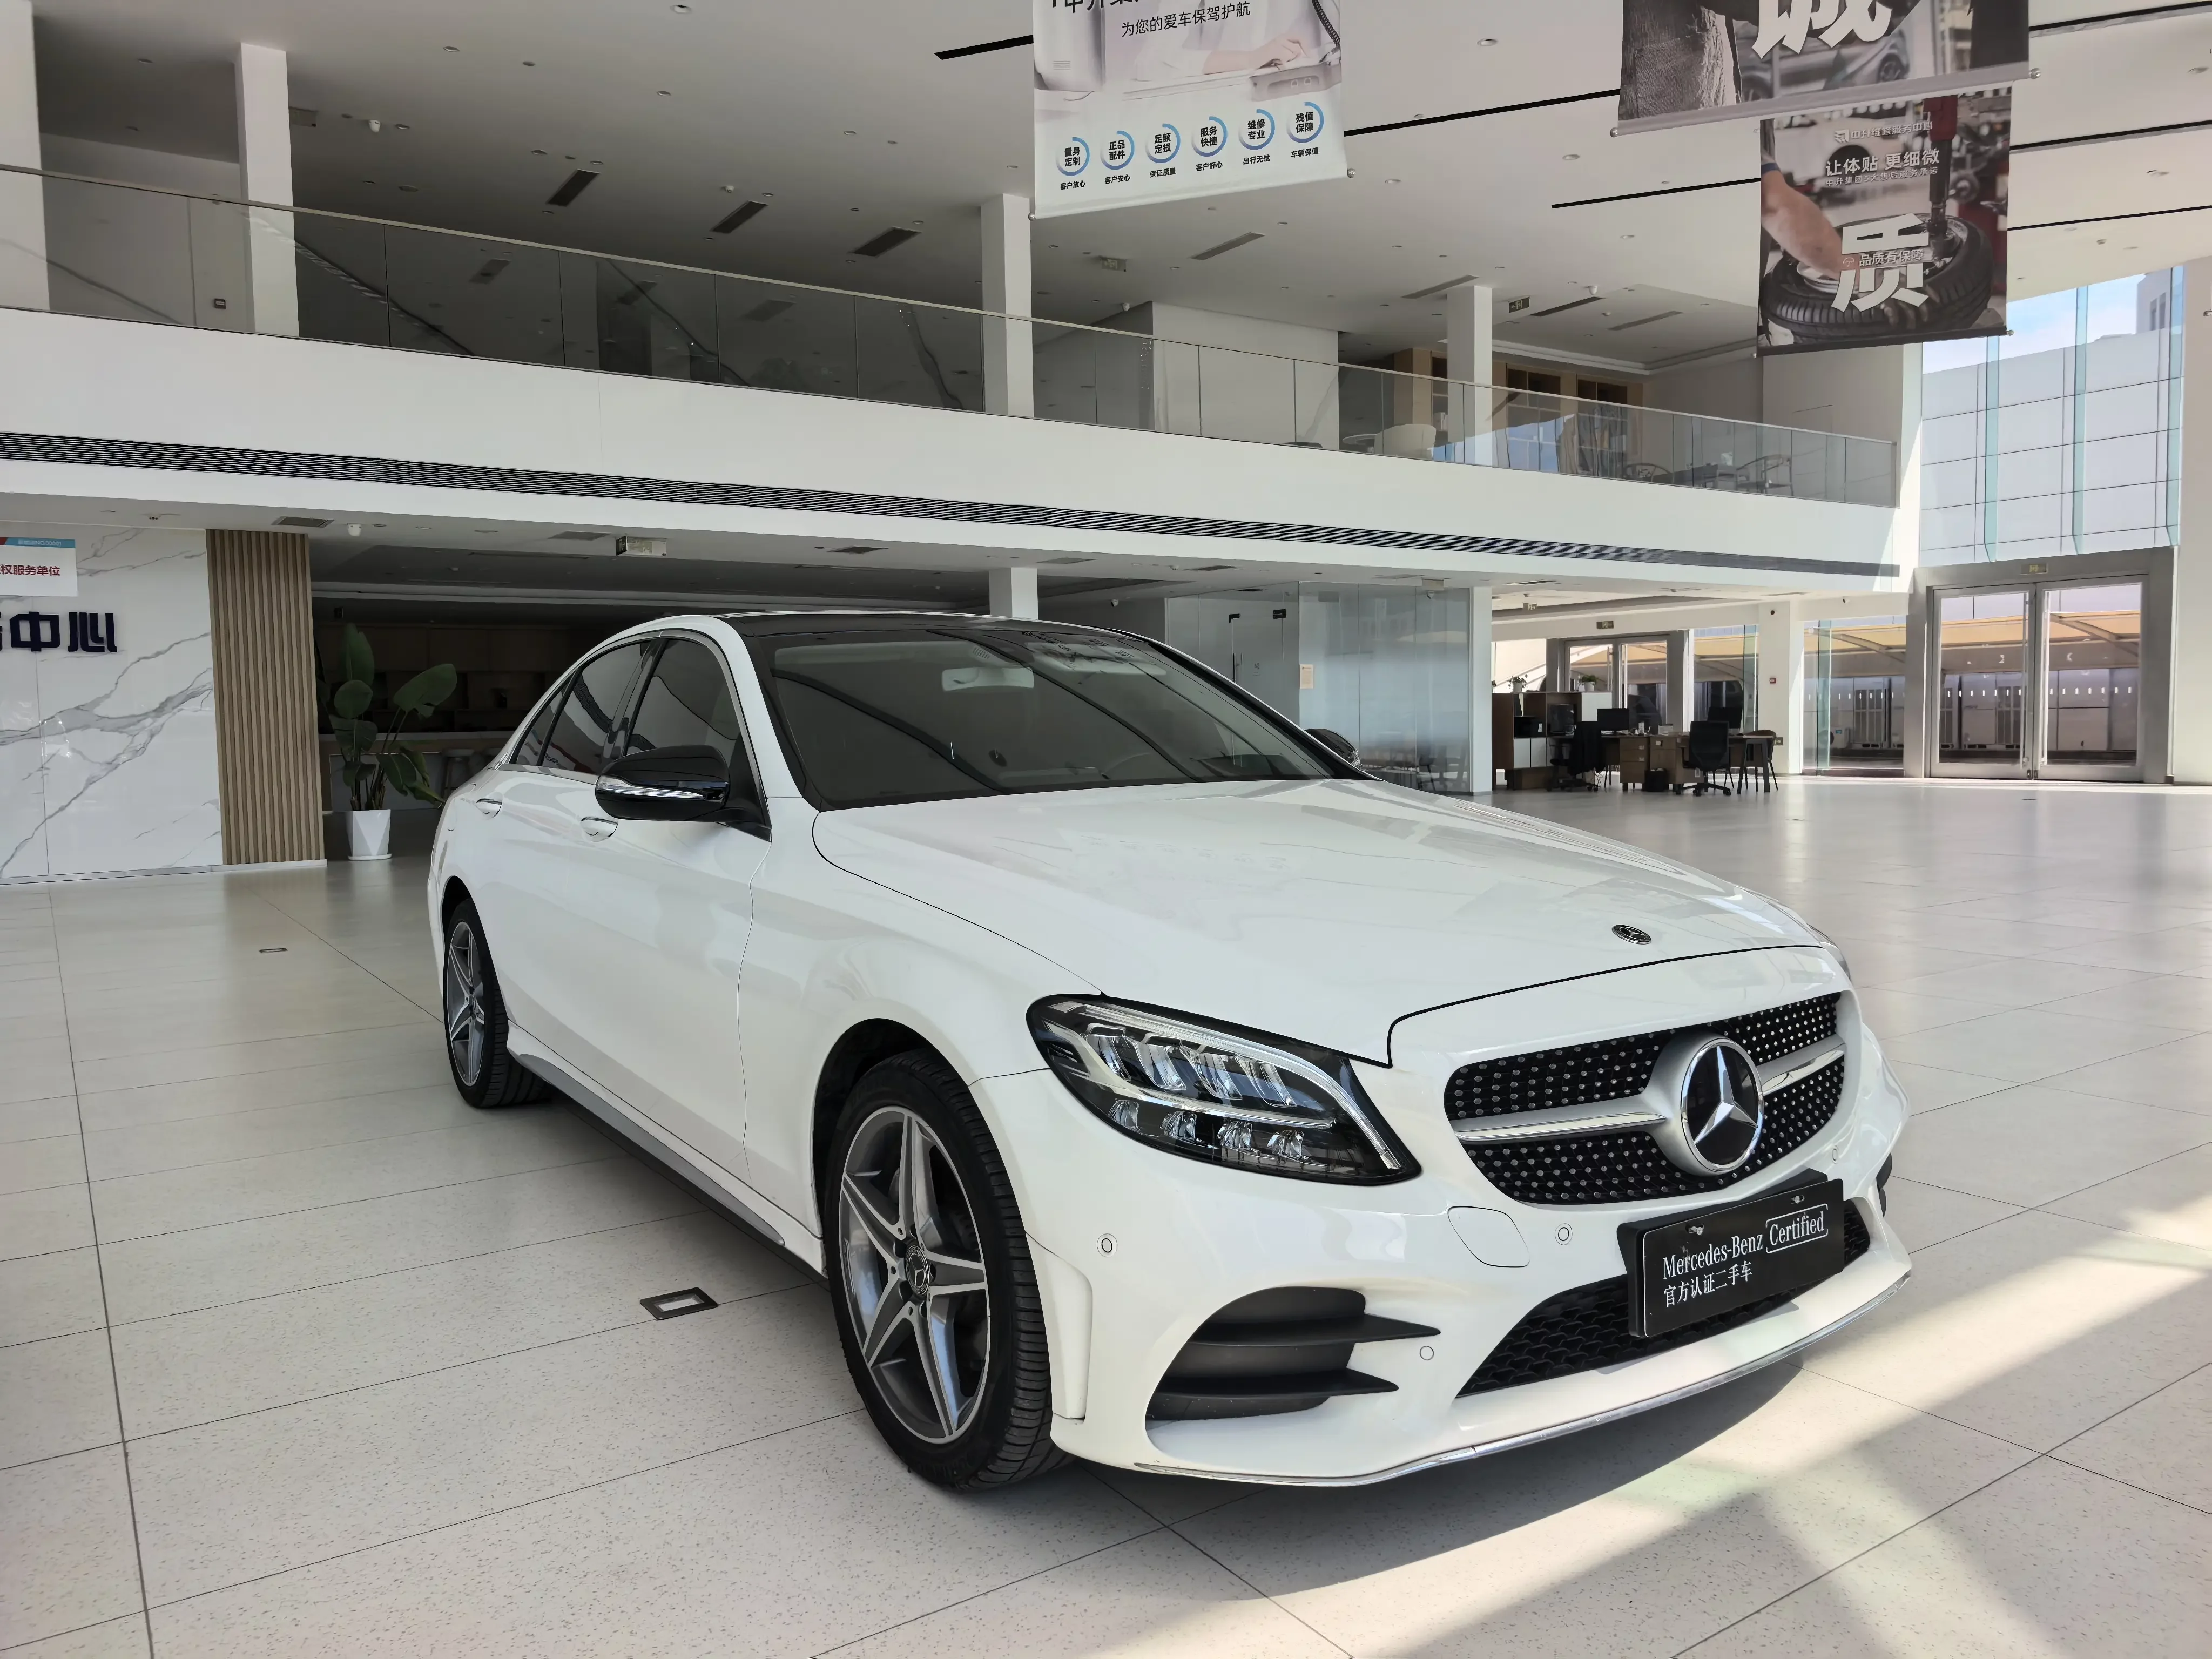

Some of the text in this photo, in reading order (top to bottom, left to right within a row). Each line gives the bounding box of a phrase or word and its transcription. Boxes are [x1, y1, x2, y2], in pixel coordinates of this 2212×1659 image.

[1122, 1, 1251, 37] 为您的爱车保驾护航
[1296, 112, 1313, 123] 残值
[1247, 119, 1265, 130] 维修
[1296, 122, 1313, 133] 保障
[1851, 121, 1933, 139] 中升维修服务中心
[1201, 126, 1217, 137] 服务
[1247, 130, 1265, 139] 专业
[1154, 133, 1171, 144] 足额
[1200, 137, 1218, 147] 快捷
[1109, 140, 1125, 150] 正品
[1154, 144, 1171, 154] 定损
[1065, 147, 1080, 157] 量身
[1109, 151, 1125, 160] 配件
[1291, 147, 1319, 158] 车辆保值
[1065, 157, 1080, 166] 定制
[1243, 154, 1270, 165] 出行无忧
[1826, 148, 1940, 176] 让体贴 更细微
[1196, 161, 1223, 171] 客户舒心
[1150, 167, 1176, 178] 保证质量
[1826, 167, 1938, 186] 中升集团5大售后服务承诺
[1104, 174, 1131, 184] 客户安心
[1060, 180, 1086, 190] 客户放心
[1859, 248, 1924, 266] 品质有保障
[0, 564, 60, 576] 权服务单位
[0, 611, 117, 652] 中心
[1663, 1211, 1824, 1280] Mercedes-Benz Certified
[1663, 1260, 1752, 1308] 官方认证二手车
